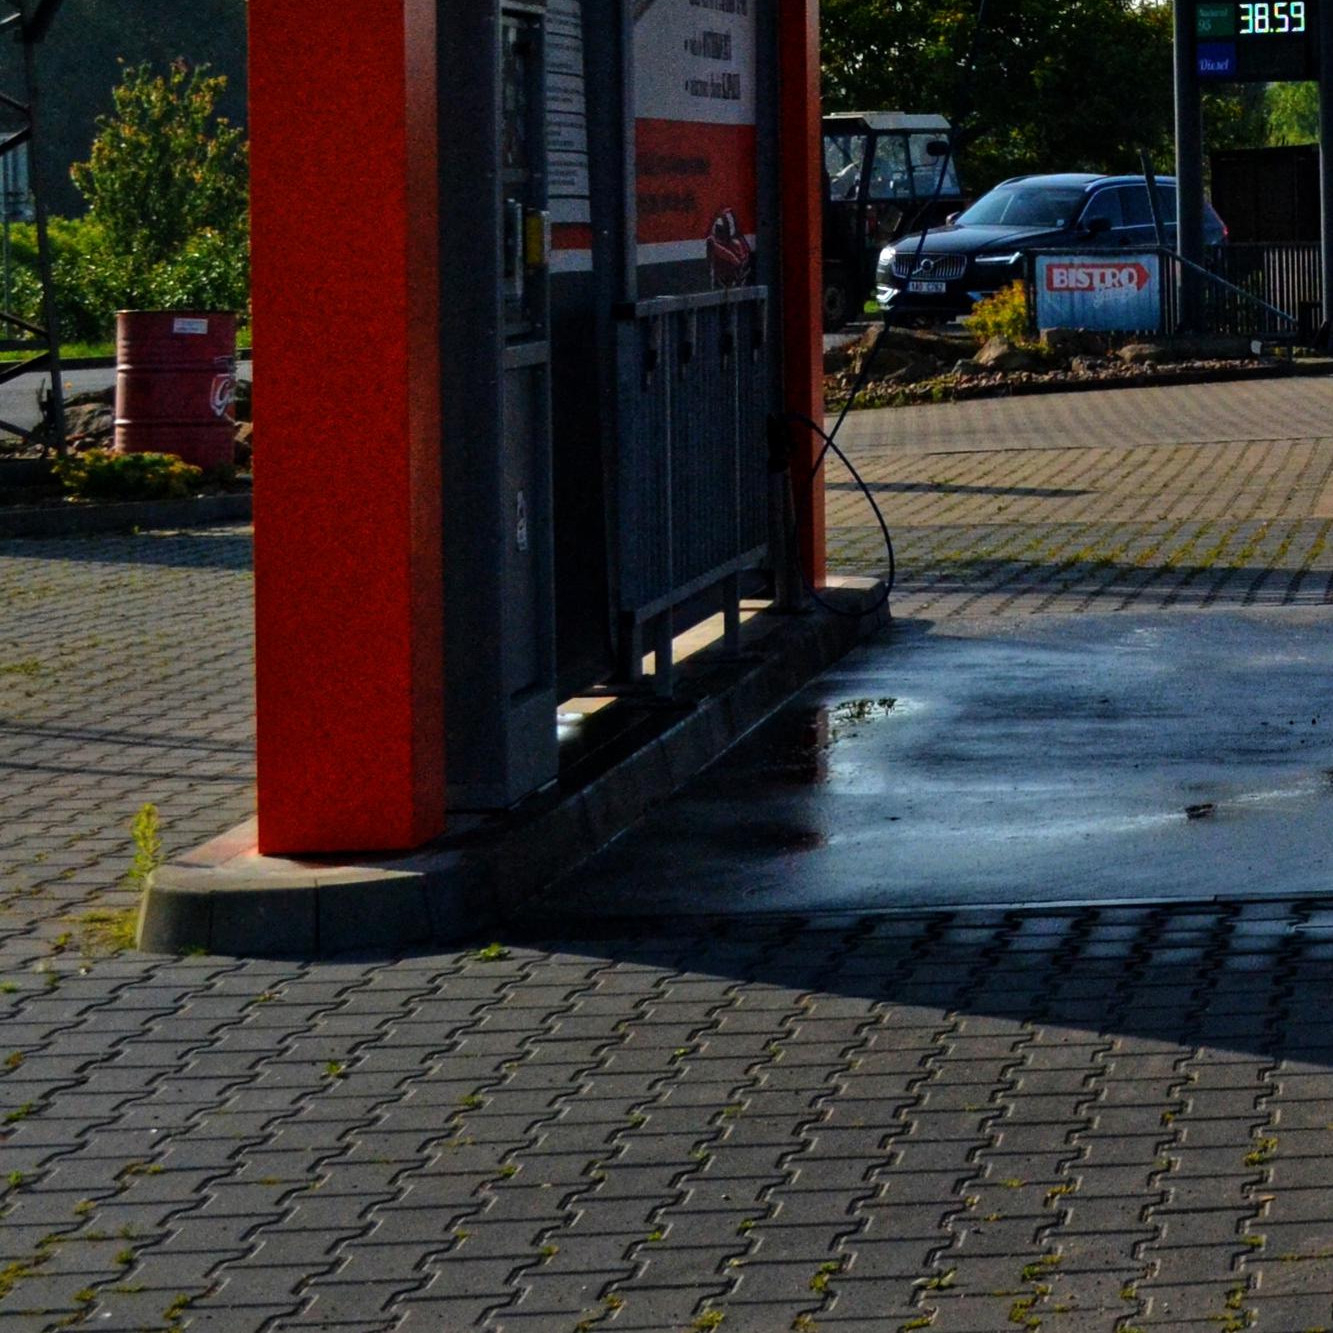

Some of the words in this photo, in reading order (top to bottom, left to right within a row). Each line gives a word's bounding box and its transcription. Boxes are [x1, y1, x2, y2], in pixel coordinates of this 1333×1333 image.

[1239, 0, 1306, 34] 38.59
[1199, 58, 1230, 72] Diesel
[1051, 266, 1138, 289] BISTRO
